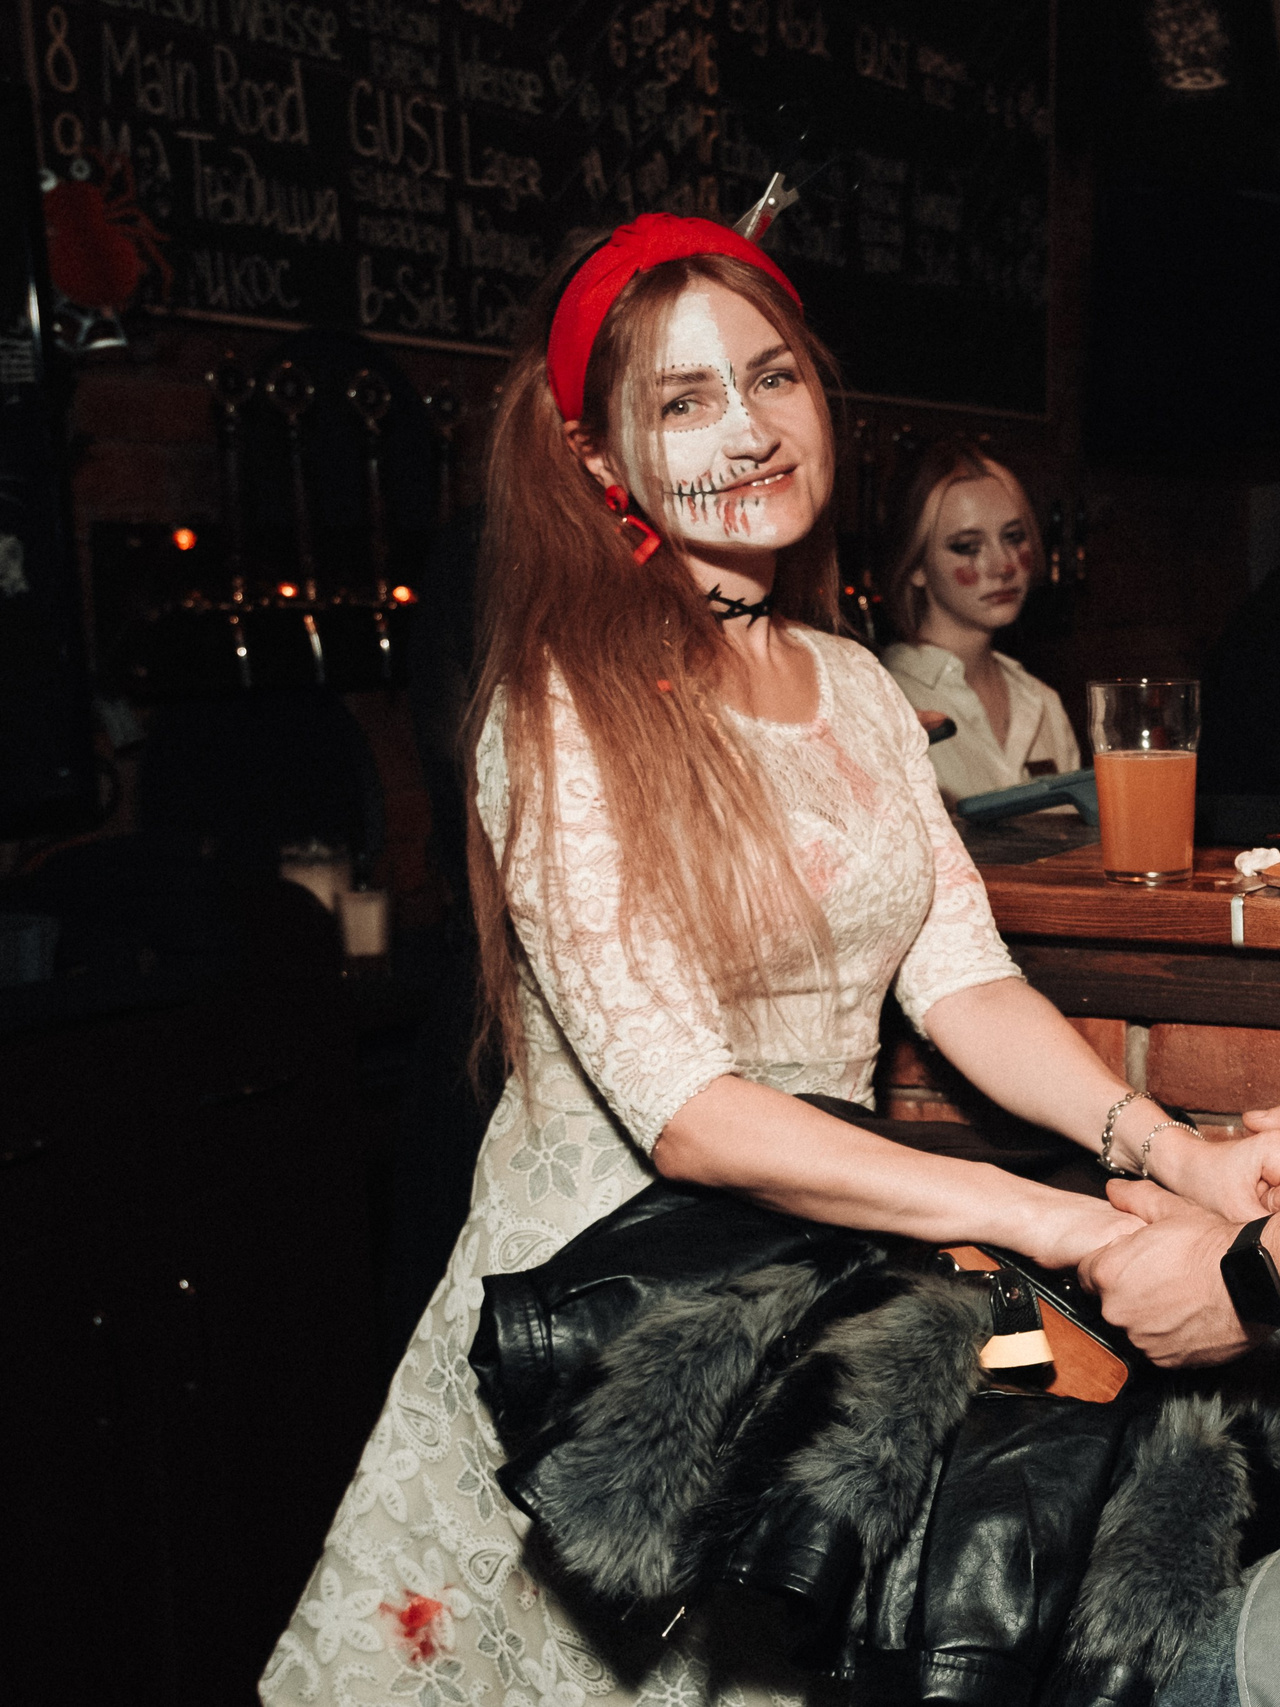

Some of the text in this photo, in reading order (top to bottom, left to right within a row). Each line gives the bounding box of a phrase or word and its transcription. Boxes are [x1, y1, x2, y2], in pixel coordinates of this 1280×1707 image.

[46, 4, 79, 94] 8
[101, 20, 201, 119] Main
[212, 43, 311, 146] Road
[349, 78, 454, 179] GUSI
